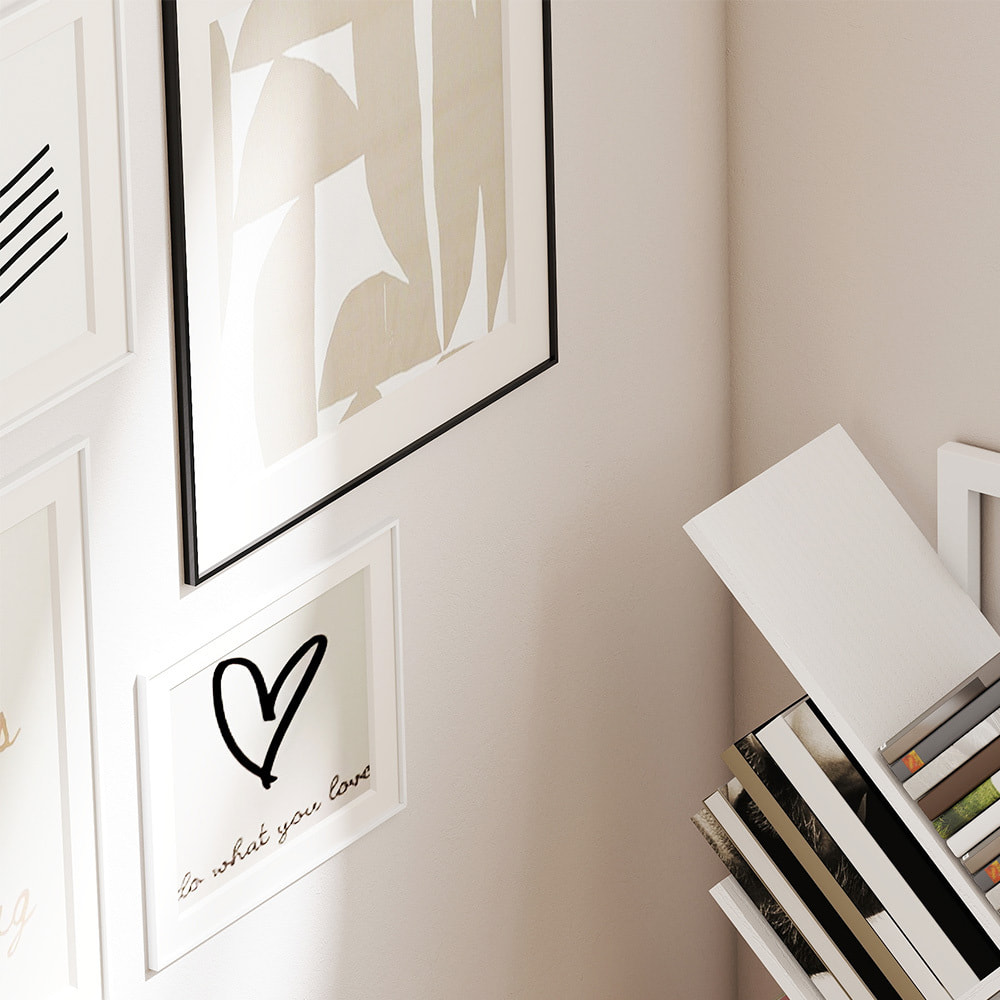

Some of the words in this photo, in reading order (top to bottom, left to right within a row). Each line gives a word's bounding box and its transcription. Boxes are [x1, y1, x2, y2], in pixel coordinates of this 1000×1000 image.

[211, 823, 271, 878] what
[277, 801, 322, 845] you
[328, 764, 371, 801] love
